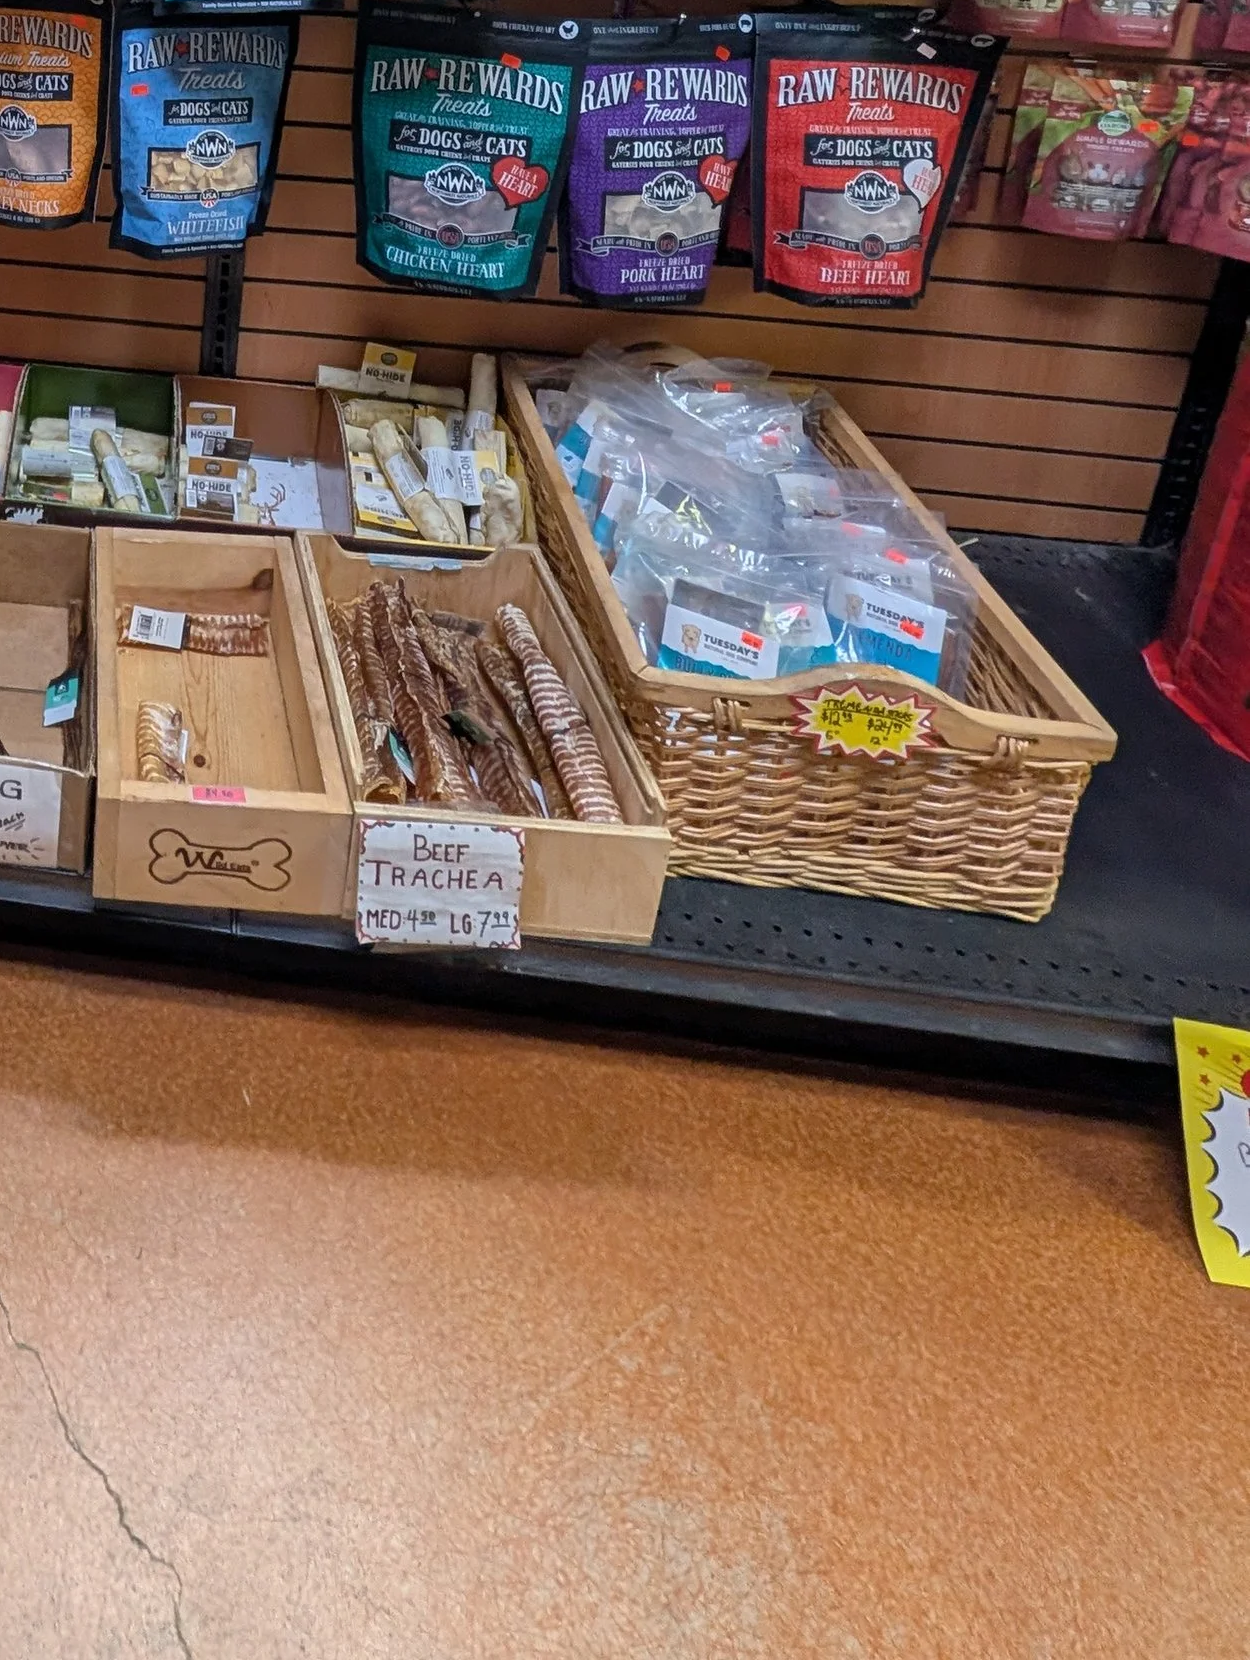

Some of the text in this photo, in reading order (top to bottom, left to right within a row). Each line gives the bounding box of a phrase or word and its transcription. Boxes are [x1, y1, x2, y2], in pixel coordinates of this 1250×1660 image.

[28, 51, 71, 68] Treats
[127, 31, 287, 74] RAW REWARDS
[370, 58, 565, 116] RAW REWARDS
[579, 66, 748, 115] RAW REWARDS
[776, 66, 966, 114] RAW REWARDS
[17, 200, 60, 215] NECKS
[167, 217, 245, 236] WHITEFISH
[385, 245, 505, 279] CHICKEN HEART
[620, 264, 706, 284] PORK HEART
[819, 268, 910, 286] BEEF HEART
[704, 634, 759, 660] TUESDAY'S
[413, 834, 470, 864] BEEF
[365, 859, 504, 891] TRACHEA
